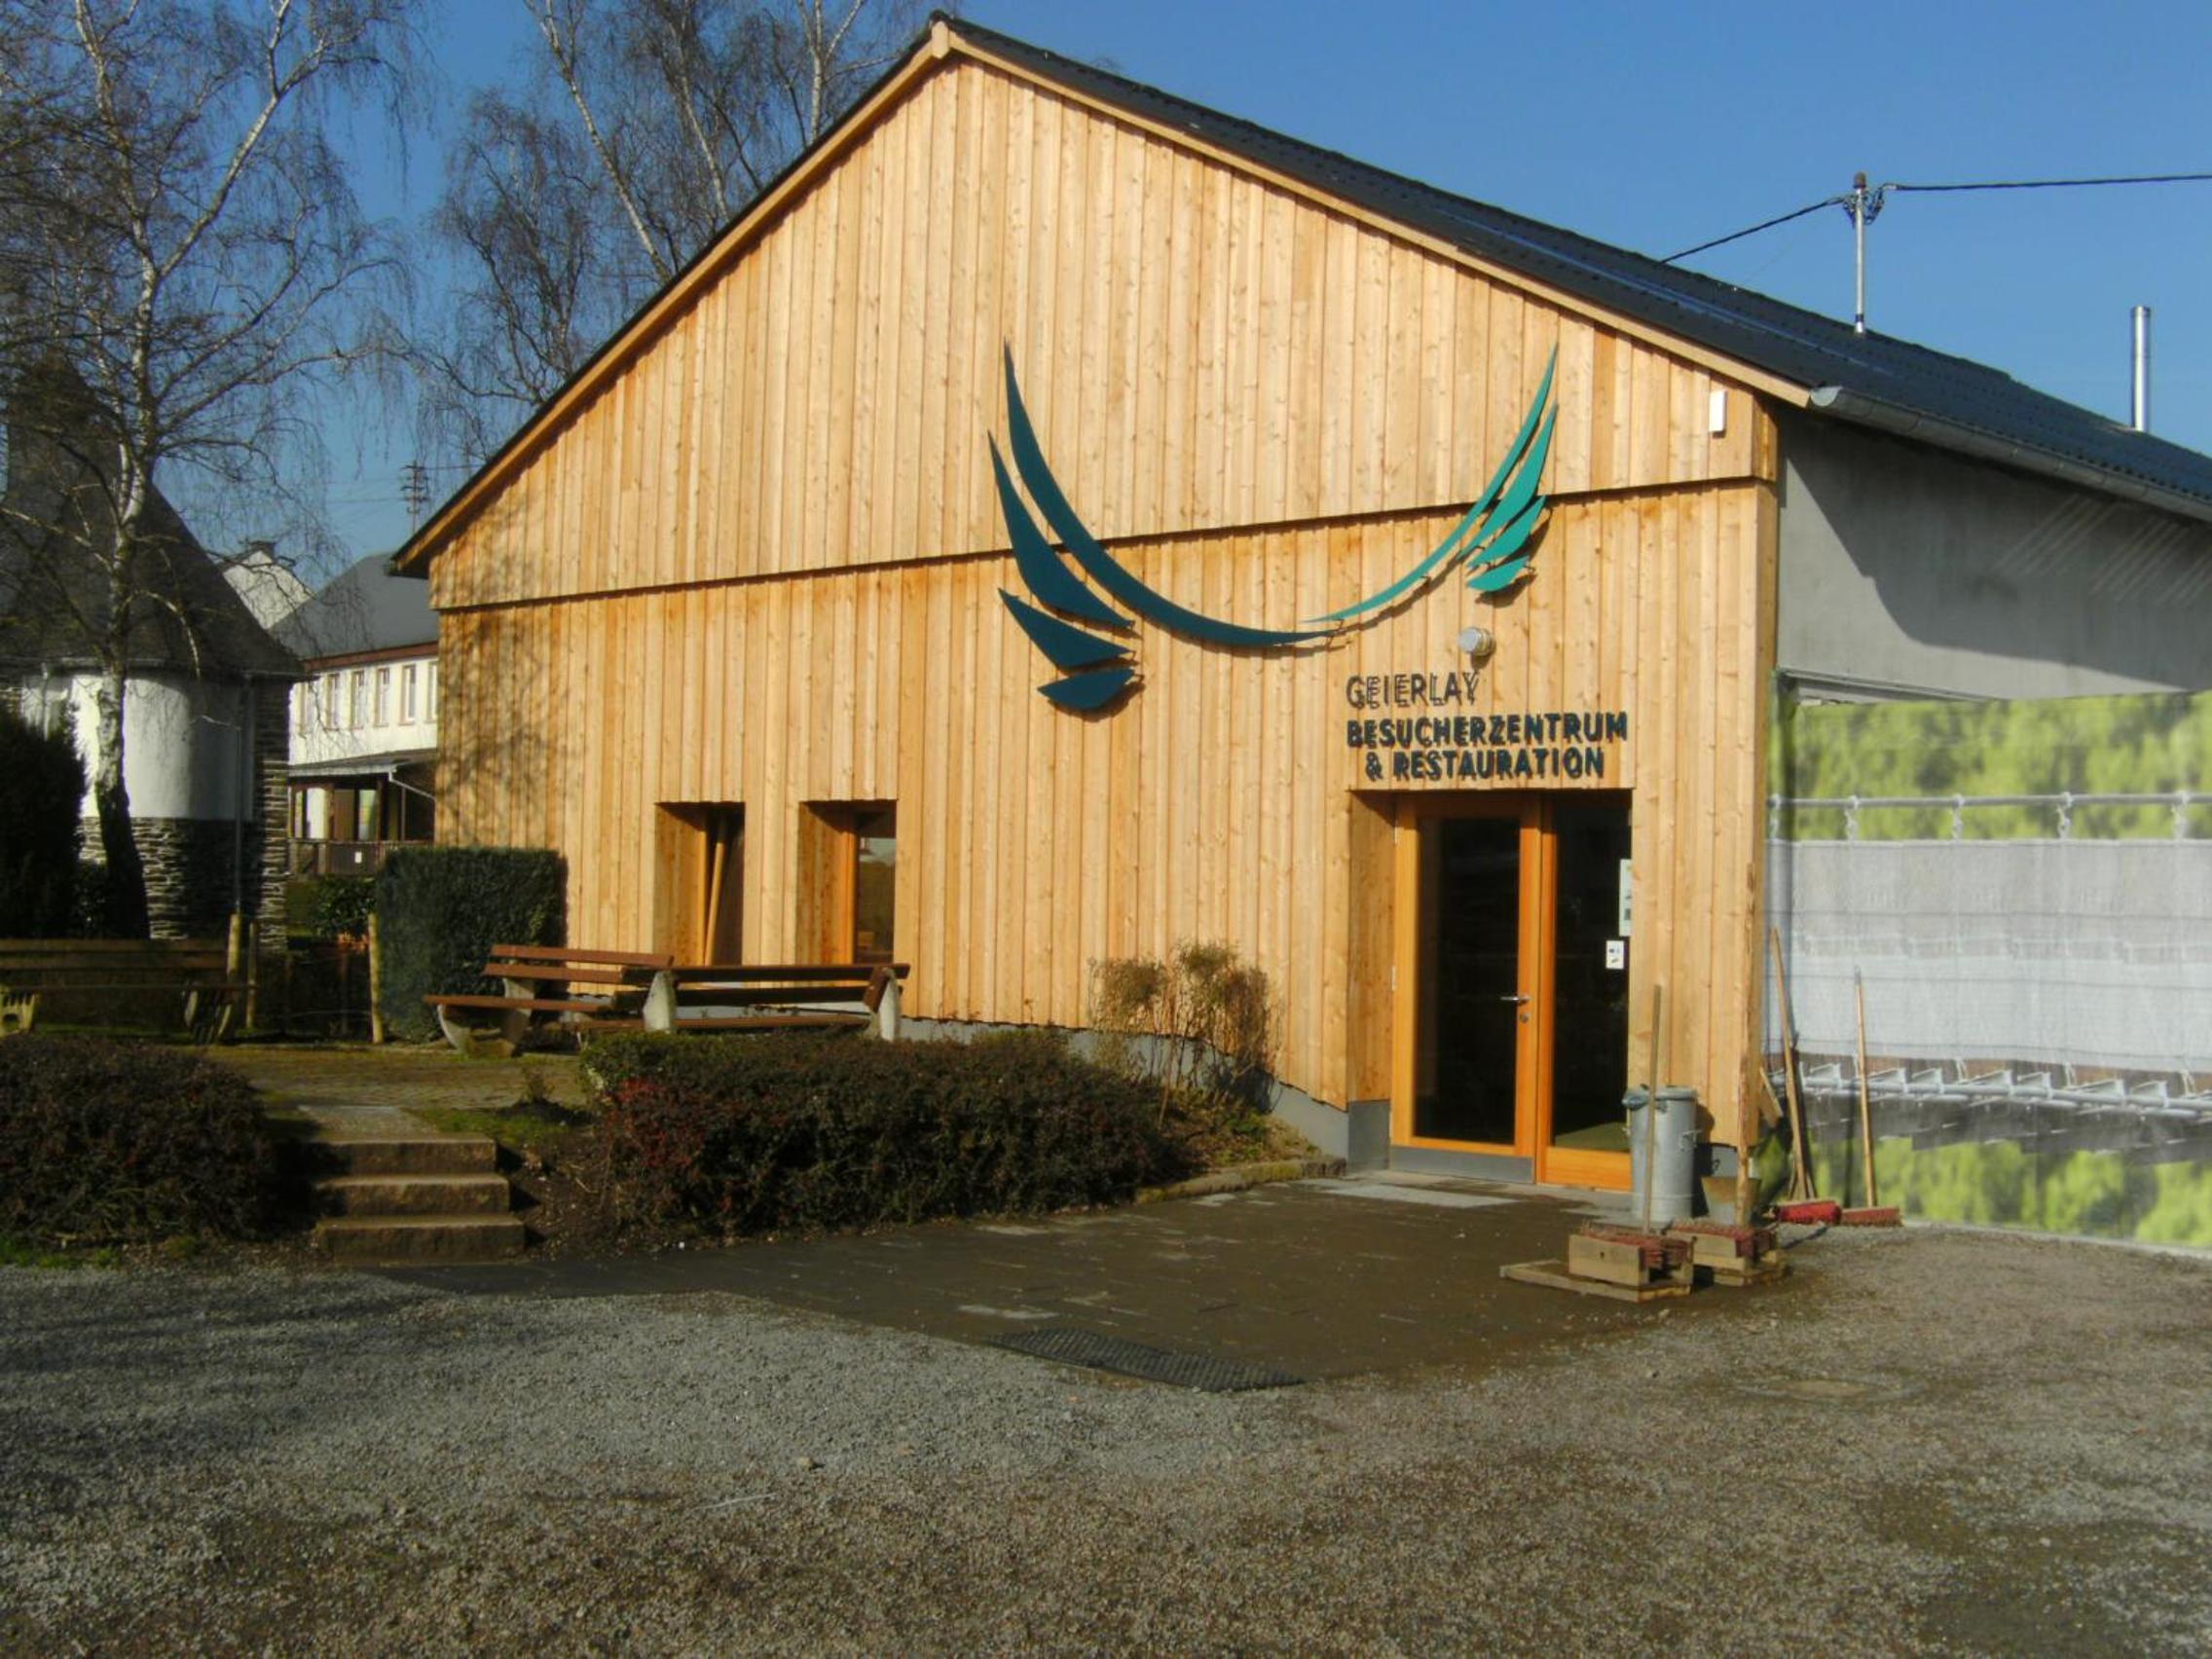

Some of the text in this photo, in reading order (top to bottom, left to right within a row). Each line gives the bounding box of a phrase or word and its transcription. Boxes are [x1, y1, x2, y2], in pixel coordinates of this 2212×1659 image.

[1346, 672, 1478, 709] GEIERLAY
[1347, 712, 1627, 748] BESUCHERZENTRUM
[1365, 747, 1604, 781] & RESTAURATION
